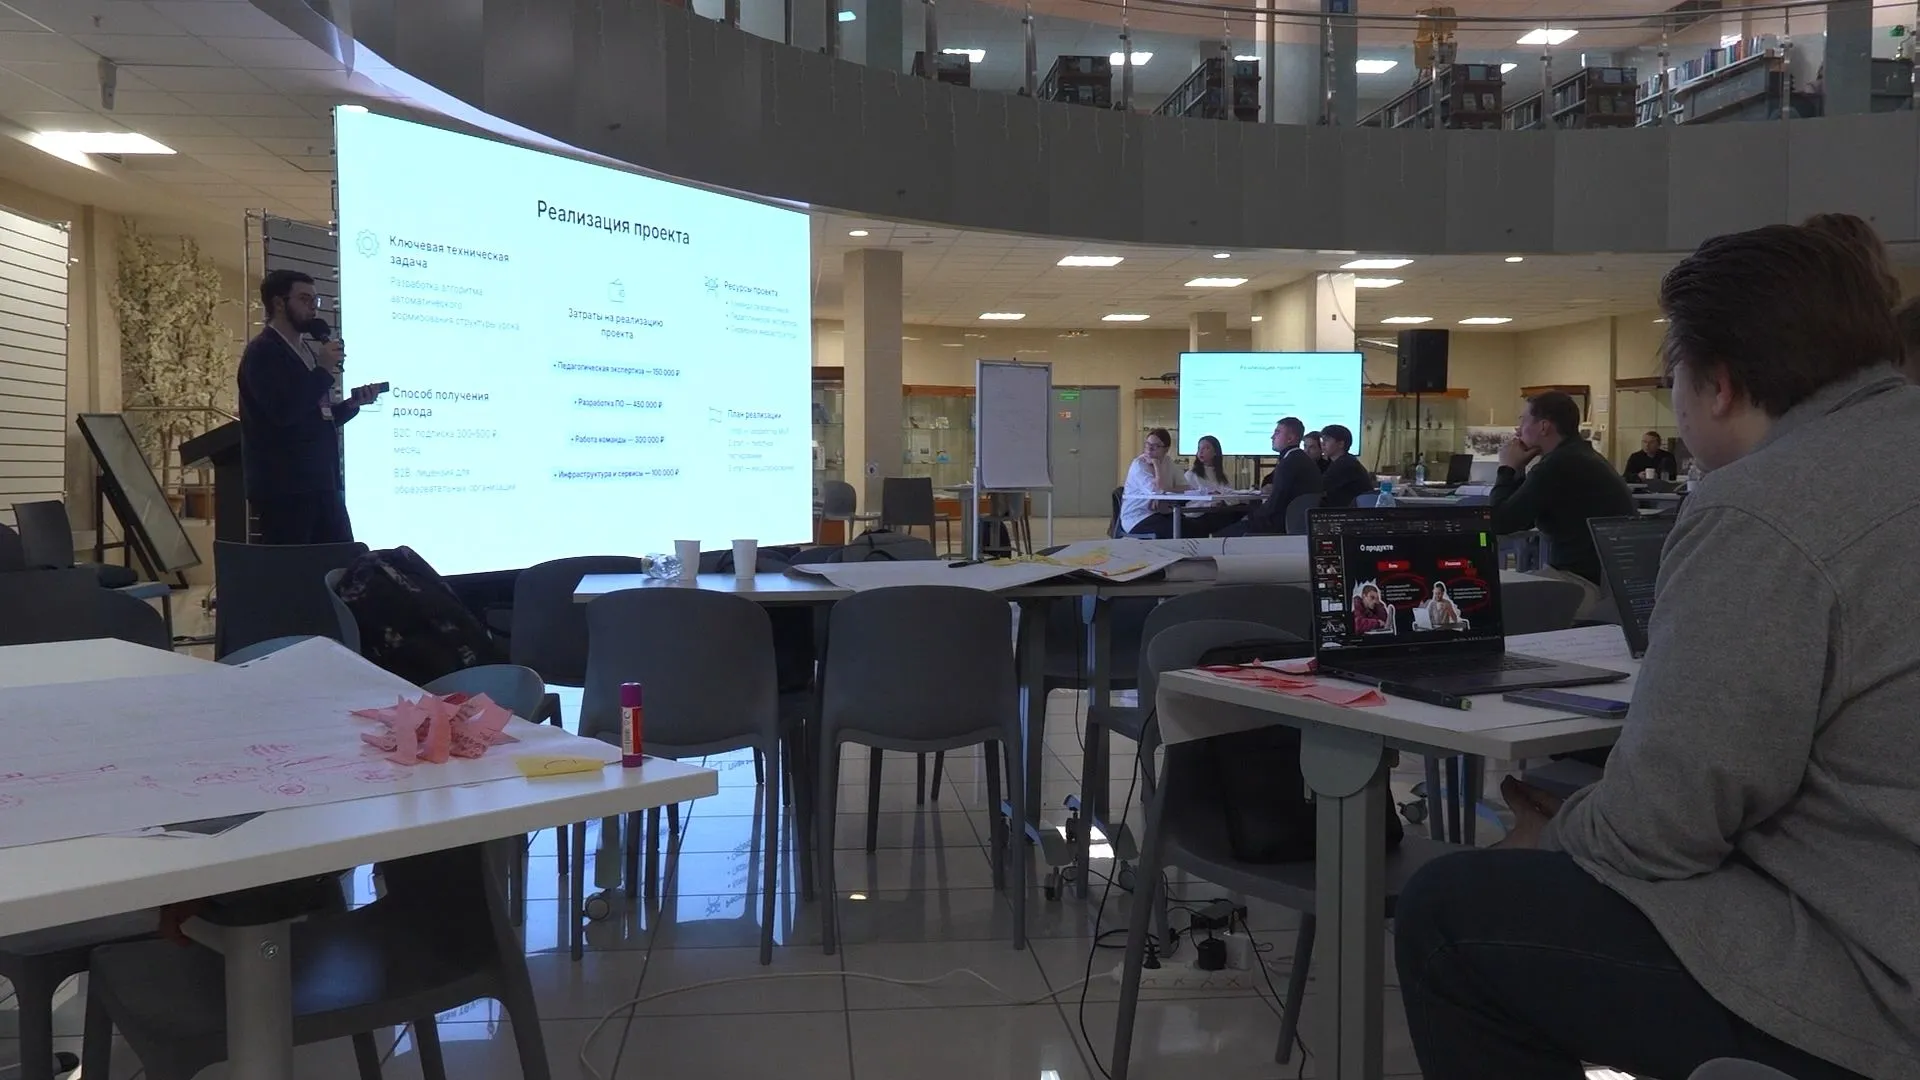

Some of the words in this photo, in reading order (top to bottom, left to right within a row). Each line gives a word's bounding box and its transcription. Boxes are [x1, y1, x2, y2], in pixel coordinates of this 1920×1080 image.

[537, 200, 630, 234] Реализация
[634, 221, 690, 245] проекта
[389, 235, 444, 254] Ключевая
[447, 245, 510, 262] техническая
[390, 256, 428, 268] задача
[568, 308, 603, 322] Затраты
[604, 315, 614, 323] на
[615, 315, 664, 328] реализацию
[600, 328, 634, 340] проекта
[557, 361, 609, 373] Педагогическая
[393, 387, 433, 400] Способ
[435, 390, 489, 403] получения
[578, 398, 614, 408] Разработка
[615, 399, 625, 408] ПО
[393, 406, 433, 418] дохода
[575, 435, 598, 444] Работа
[598, 436, 627, 445] команды
[558, 470, 612, 480] Инфраструктура
[1359, 543, 1366, 552] О
[1366, 543, 1395, 554] продукте
